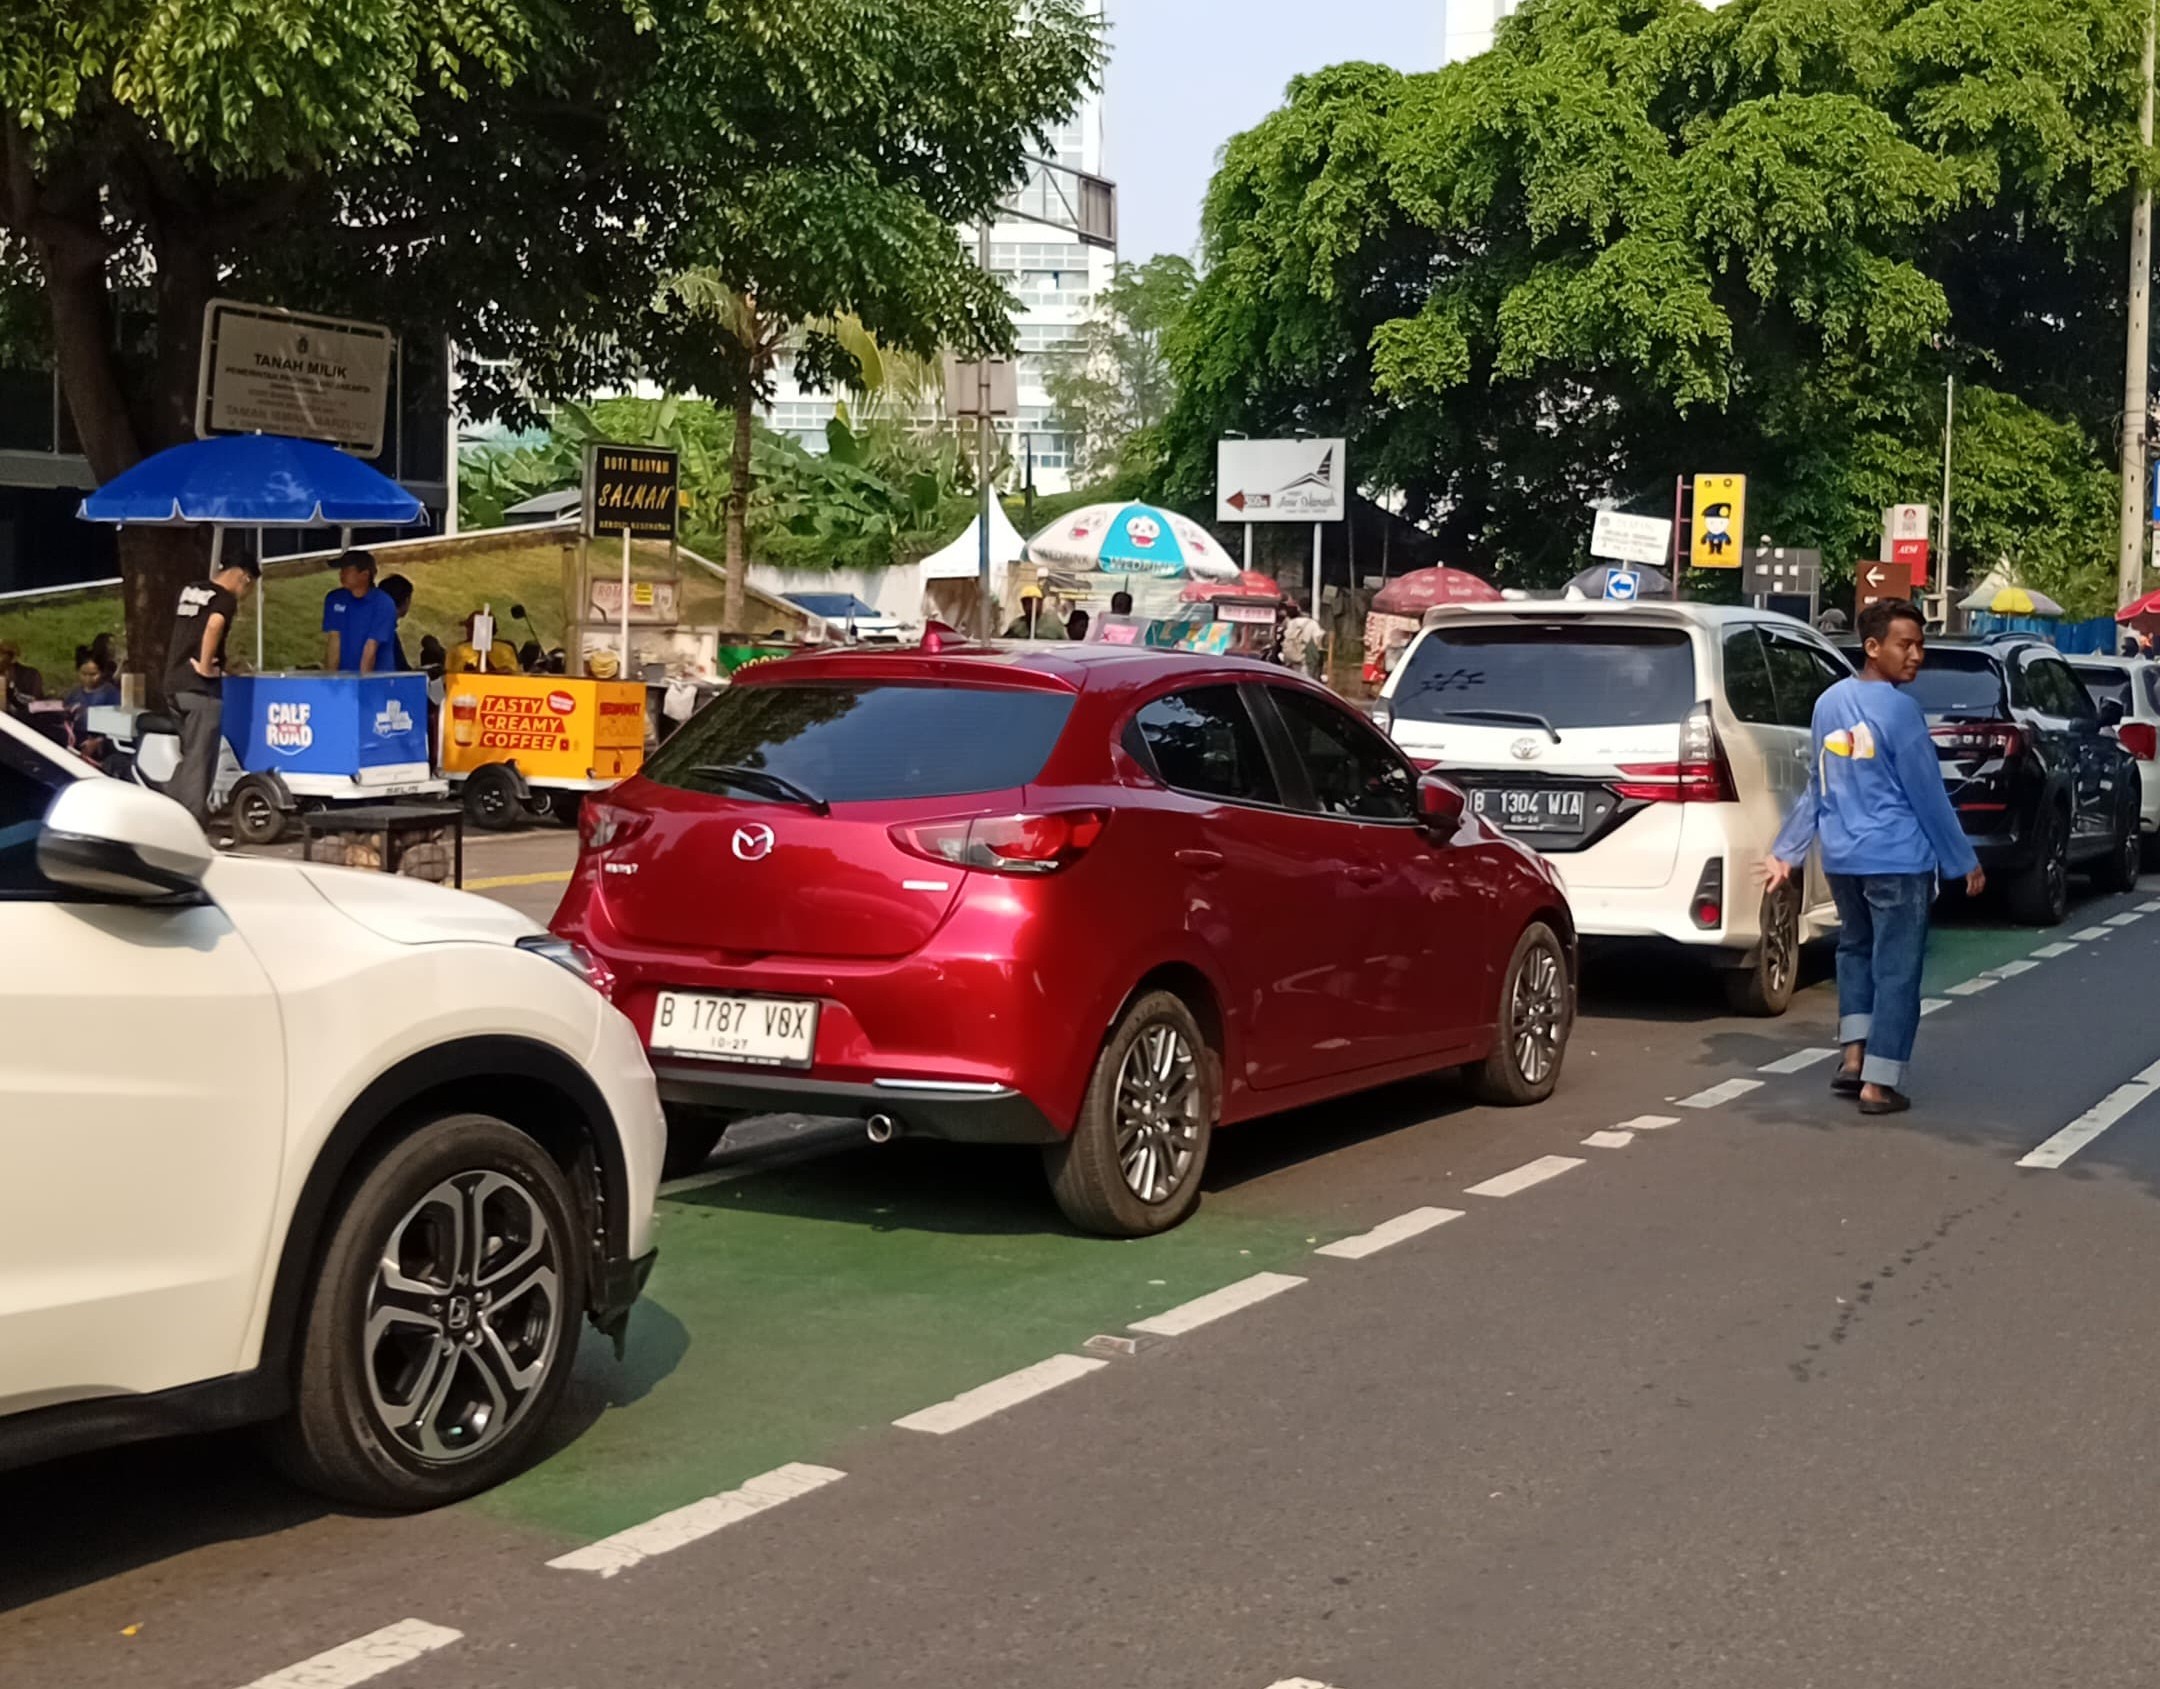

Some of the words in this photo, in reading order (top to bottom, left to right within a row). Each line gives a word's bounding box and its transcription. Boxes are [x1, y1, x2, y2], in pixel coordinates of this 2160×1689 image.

[254, 353, 303, 372] TANAH
[307, 361, 347, 379] MILIK
[598, 483, 674, 509] SALMAN
[486, 697, 542, 715] TASTY
[266, 723, 313, 747] ROAD
[484, 714, 561, 733] CREAMY
[483, 732, 554, 751] COFFEE
[1474, 792, 1485, 813] B
[1501, 792, 1539, 813] 1304
[1548, 794, 1580, 815] WIA
[660, 996, 675, 1027] B
[692, 999, 746, 1033] 1787
